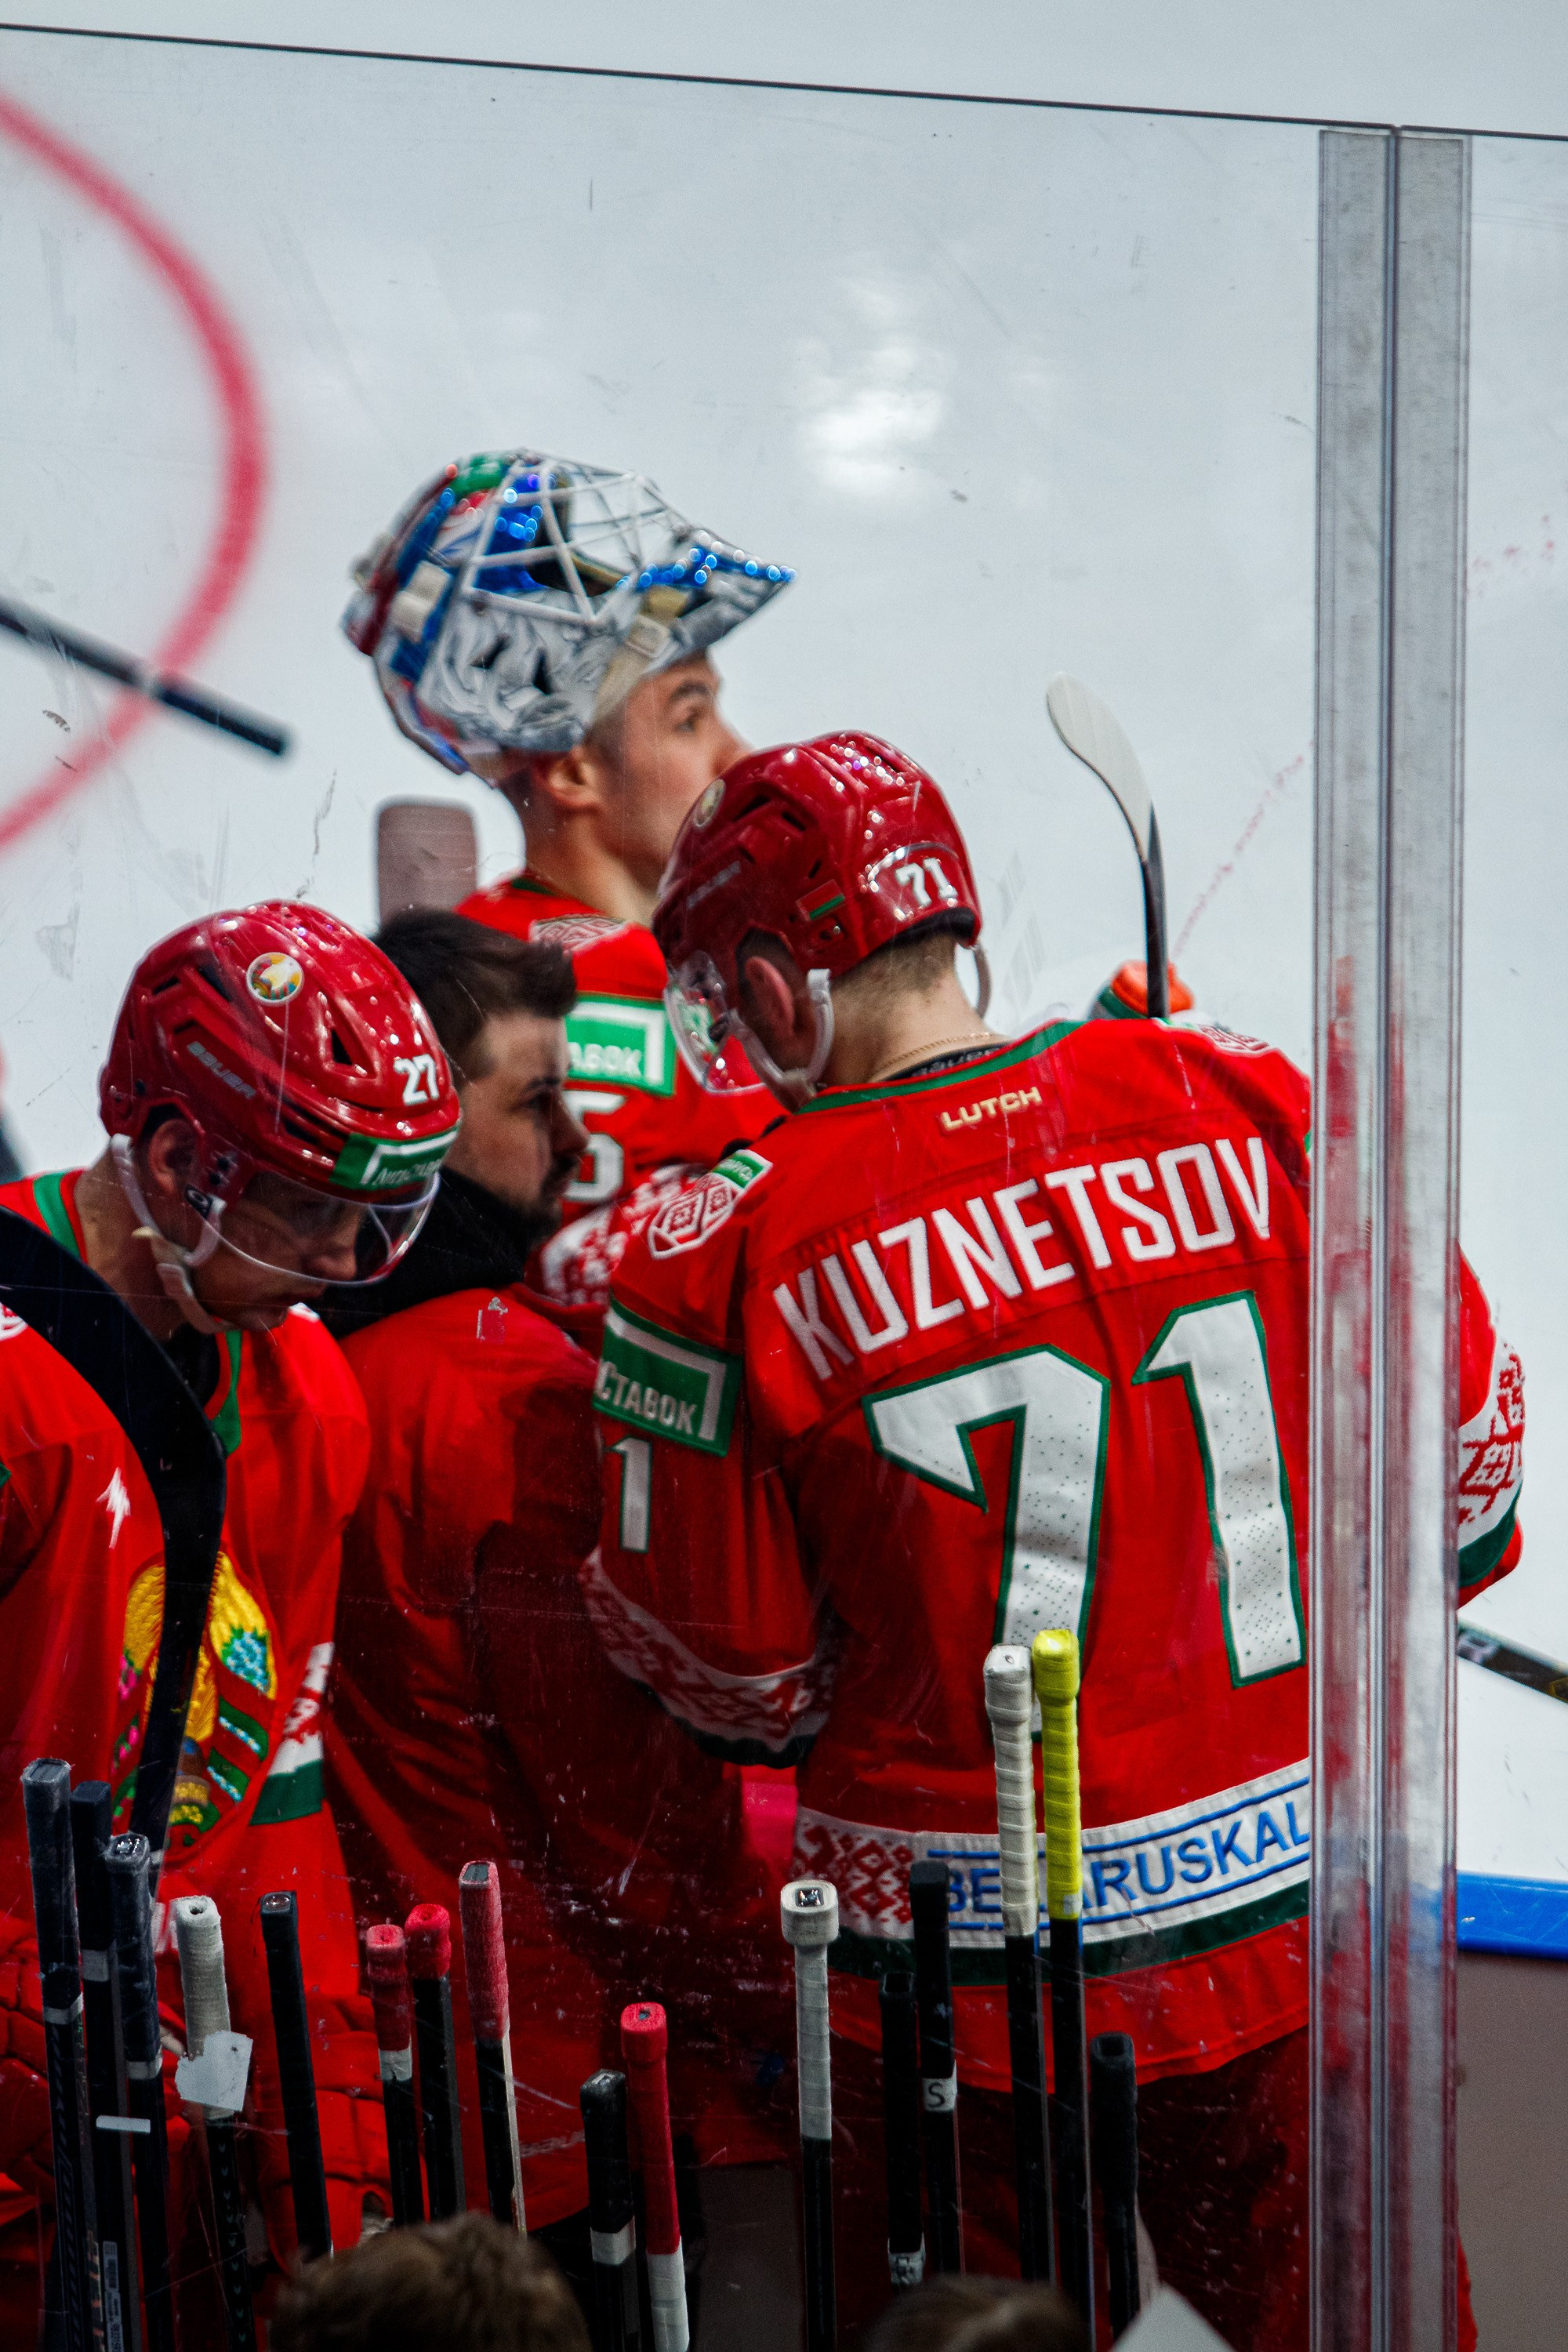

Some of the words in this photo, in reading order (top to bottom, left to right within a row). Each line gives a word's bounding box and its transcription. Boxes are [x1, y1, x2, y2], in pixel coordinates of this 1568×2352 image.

[895, 858, 957, 907] 71
[394, 1054, 440, 1106] 27
[942, 1087, 1042, 1131] LUTCH
[772, 1137, 1271, 1381] KUZNETSOV
[862, 1290, 1307, 1744] 71
[949, 1801, 1310, 1913] BERUSKAL
[927, 2081, 946, 2108] S
